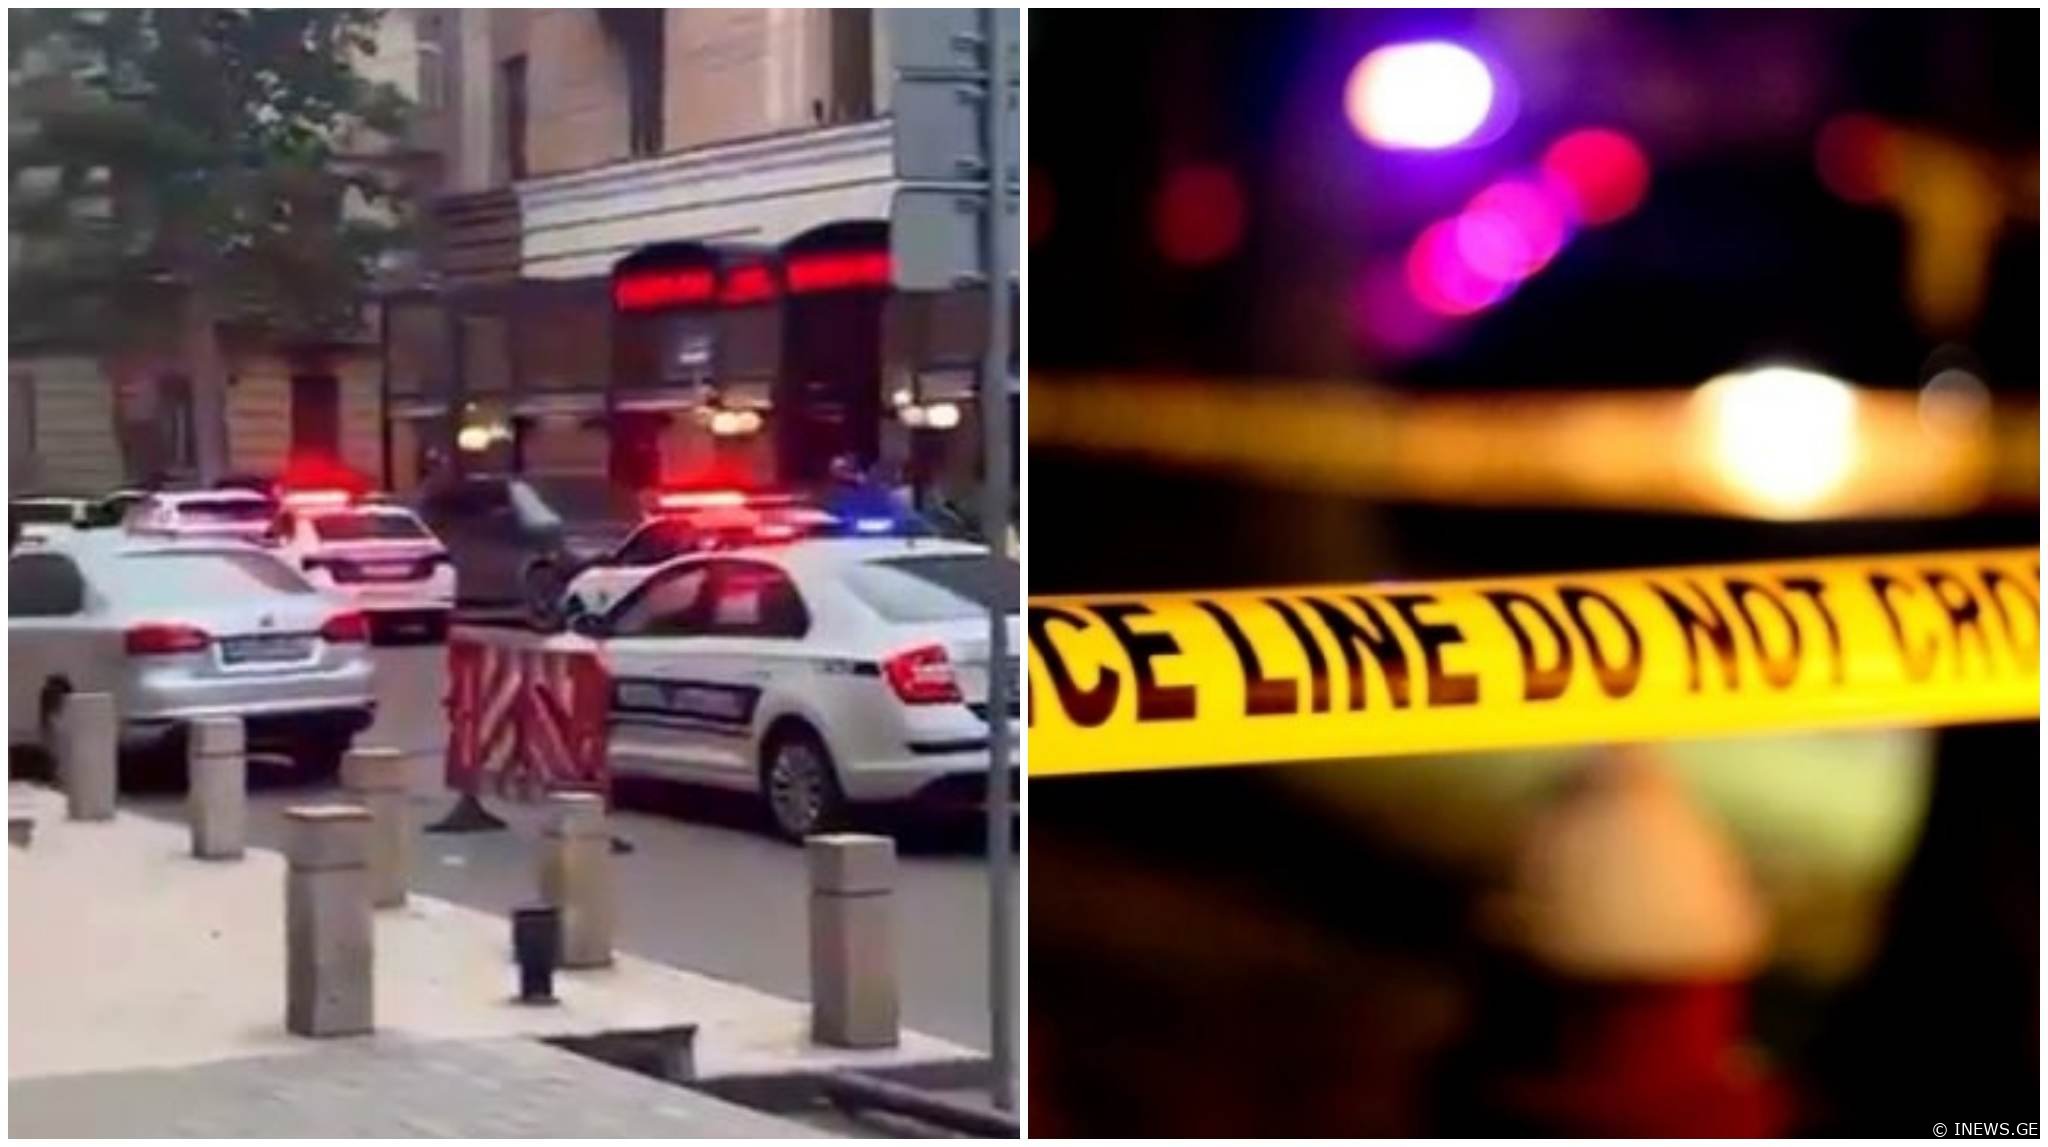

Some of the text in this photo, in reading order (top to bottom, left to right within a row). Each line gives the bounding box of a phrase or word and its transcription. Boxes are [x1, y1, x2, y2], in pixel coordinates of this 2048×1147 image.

[1028, 564, 2040, 728] CE LINE DO NOT CRO
